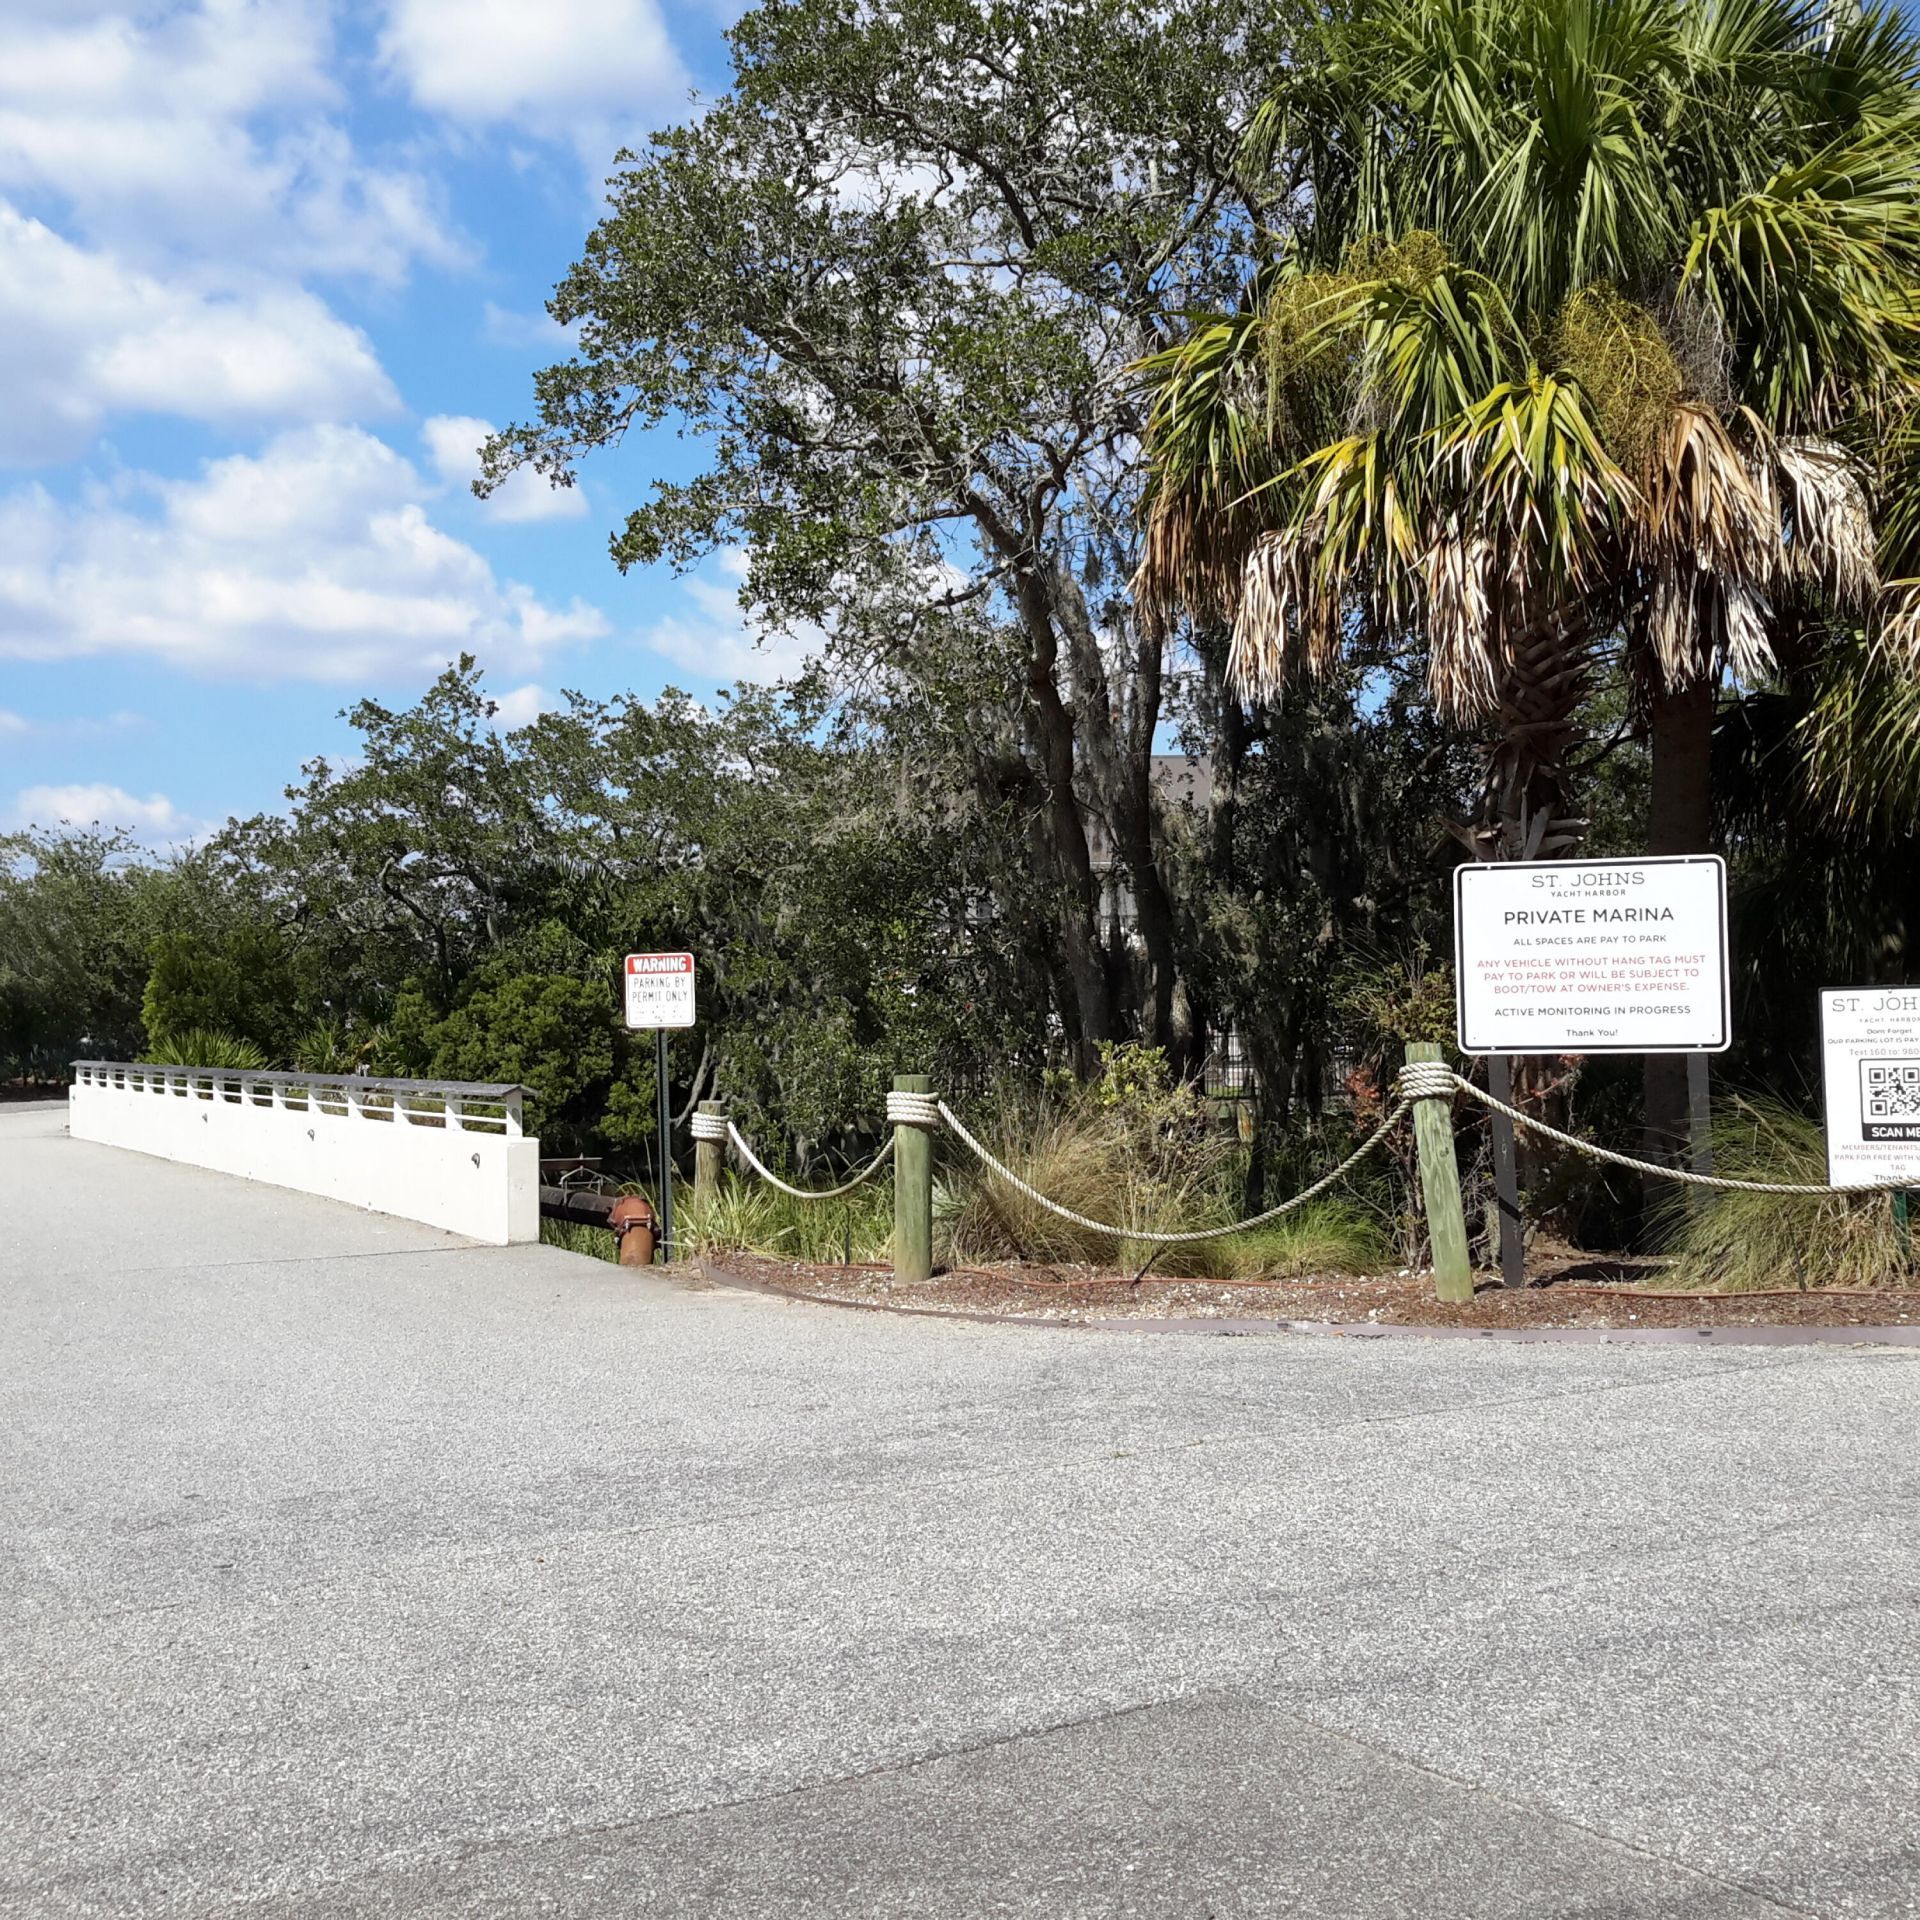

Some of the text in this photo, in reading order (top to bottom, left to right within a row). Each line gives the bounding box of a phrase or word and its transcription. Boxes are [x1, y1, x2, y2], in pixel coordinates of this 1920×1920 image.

[1531, 871, 1645, 888] ST. JOHNS
[1551, 889, 1626, 898] YACHT HARBOR
[1504, 907, 1674, 925] PRIVATE MARINA
[1513, 934, 1667, 946] ALL SPACES ARE PAY TO PARK
[632, 957, 687, 973] WARNING
[1477, 954, 1706, 968] ANY VEHICLE WITHOUT HANG TAG MUST
[1484, 968, 1699, 981] PAY TO PARK OR WILL BE SUBJECT TO
[633, 976, 686, 989] PARKING BY
[1494, 982, 1690, 994] BOOT/TOW AT OWNER'S EXPENSE.
[632, 990, 688, 1003] PERMIT ONLY
[1832, 996, 1920, 1012] ST. JOH
[1494, 1005, 1691, 1017] ACTIVE MONITORING IN PROGRESS
[1566, 1029, 1618, 1037] Thank You!
[1871, 1126, 1903, 1137] SCAN
